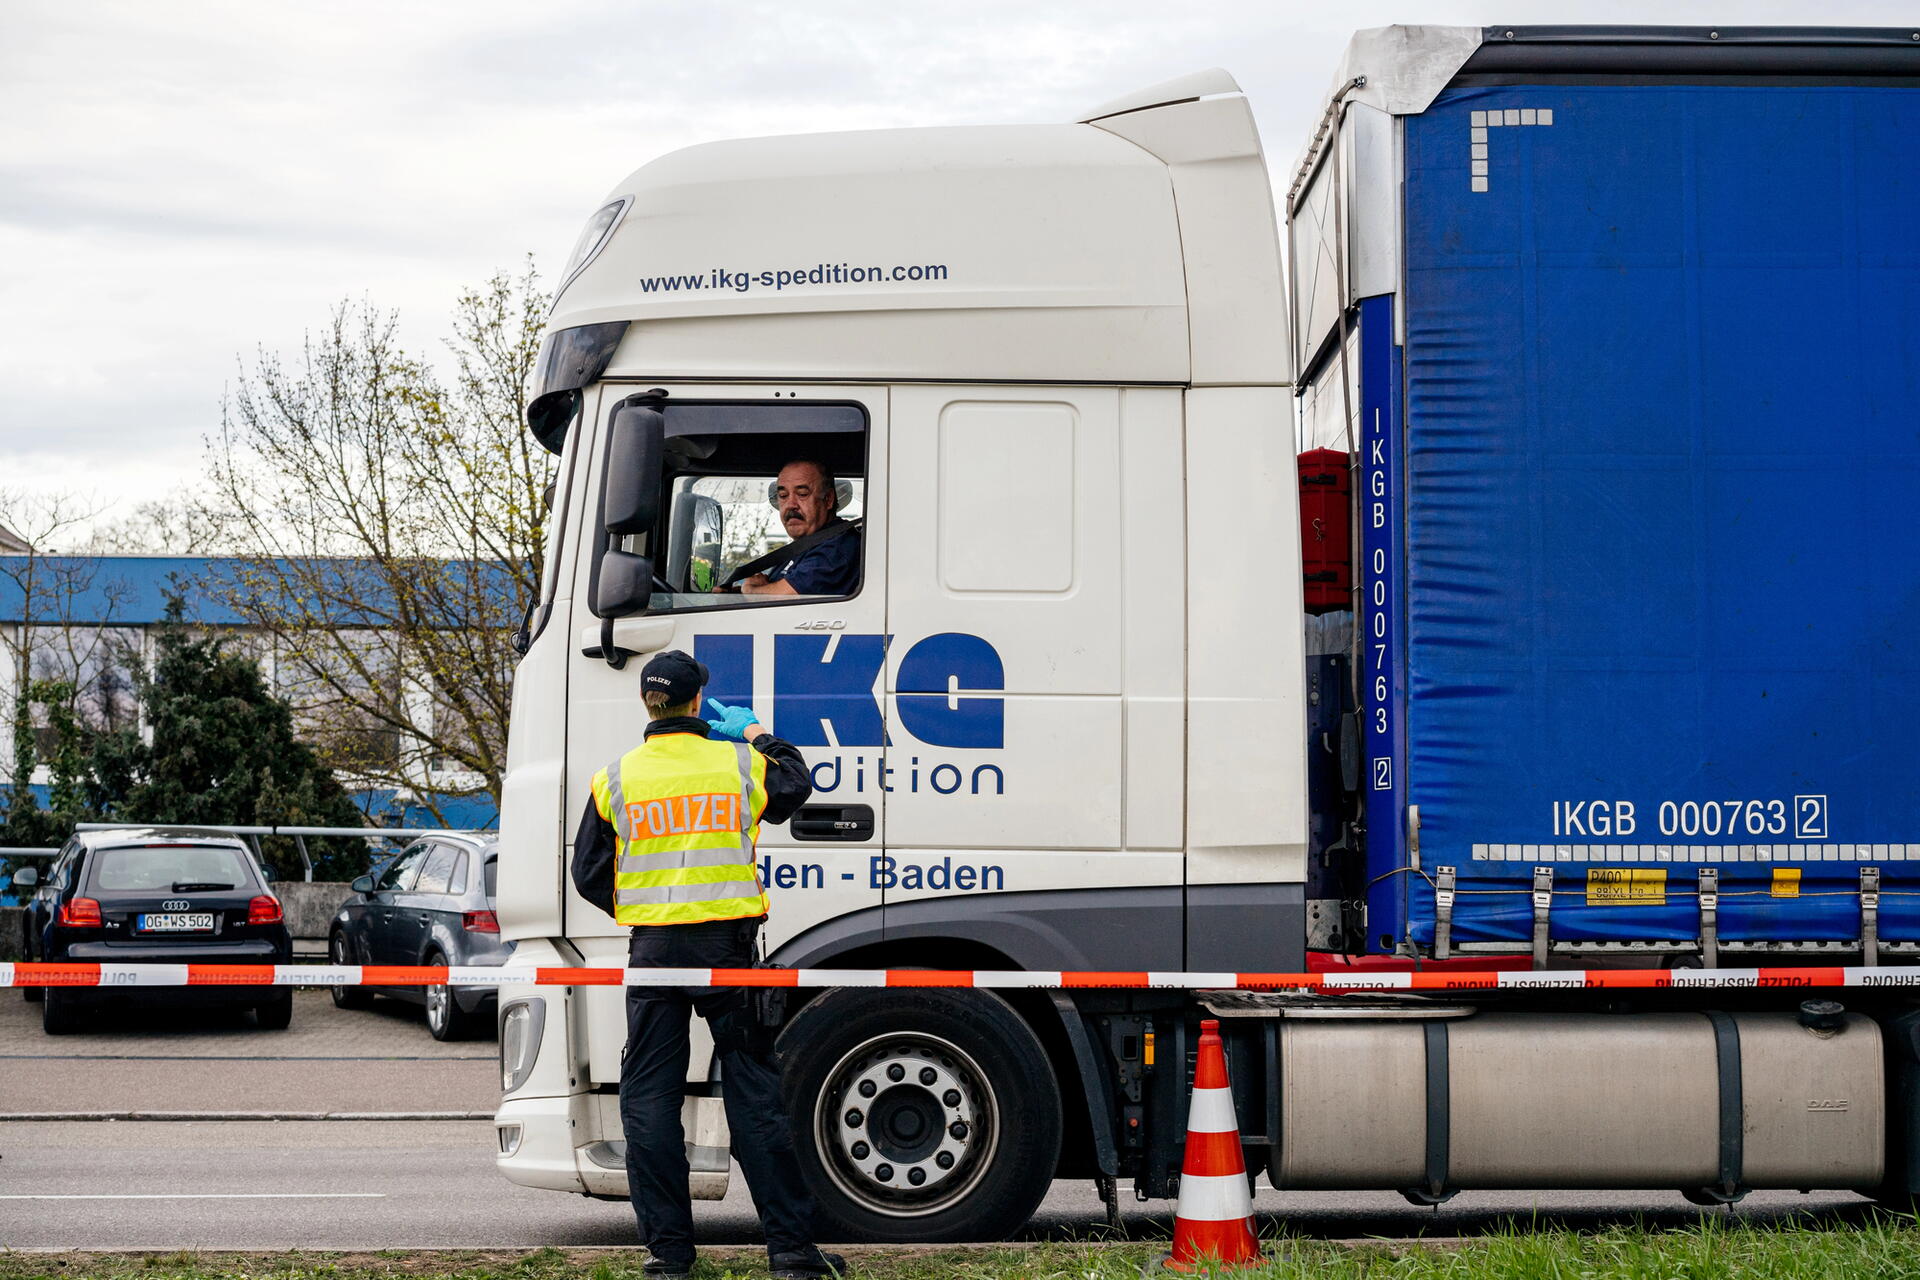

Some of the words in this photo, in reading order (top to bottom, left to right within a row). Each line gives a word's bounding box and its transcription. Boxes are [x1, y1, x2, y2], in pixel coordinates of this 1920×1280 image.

[640, 263, 948, 293] www.ikg-spedition.com
[1371, 408, 1385, 529] IKGB
[794, 620, 847, 631] 460
[1373, 548, 1387, 734] 000763
[647, 676, 671, 686] POLIZEI
[694, 633, 1004, 749] IKG
[629, 795, 736, 839] POLIZEI
[1553, 801, 1636, 836] IKGB
[1658, 800, 1787, 835] 000763
[1801, 799, 1822, 834] 2
[869, 856, 1004, 890] Baden
[146, 915, 162, 928] OG
[170, 915, 186, 928] WS
[188, 915, 212, 928] 502
